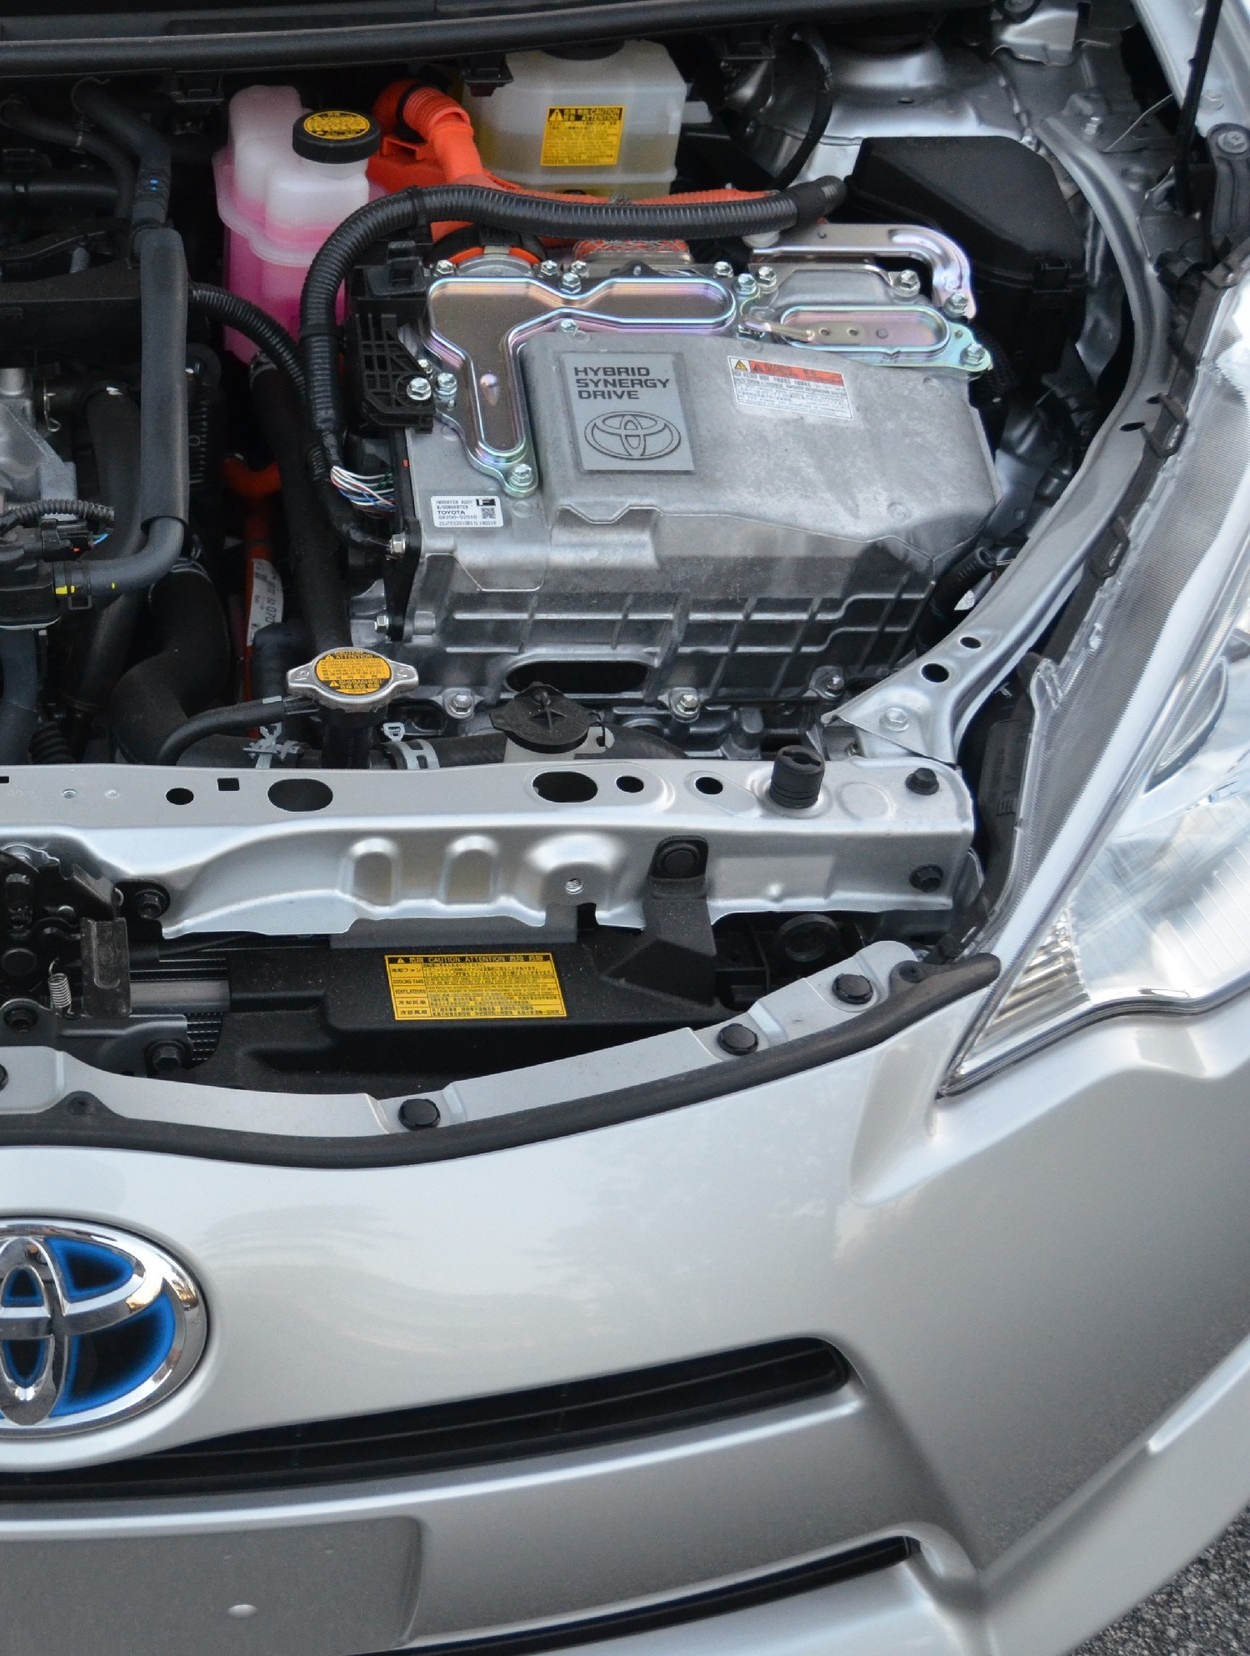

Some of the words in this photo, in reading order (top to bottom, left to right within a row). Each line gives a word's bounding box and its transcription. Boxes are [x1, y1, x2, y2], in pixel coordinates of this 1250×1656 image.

[574, 366, 650, 377] HYBRID
[575, 378, 670, 388] SYNERGY
[577, 390, 640, 400] DRIVE
